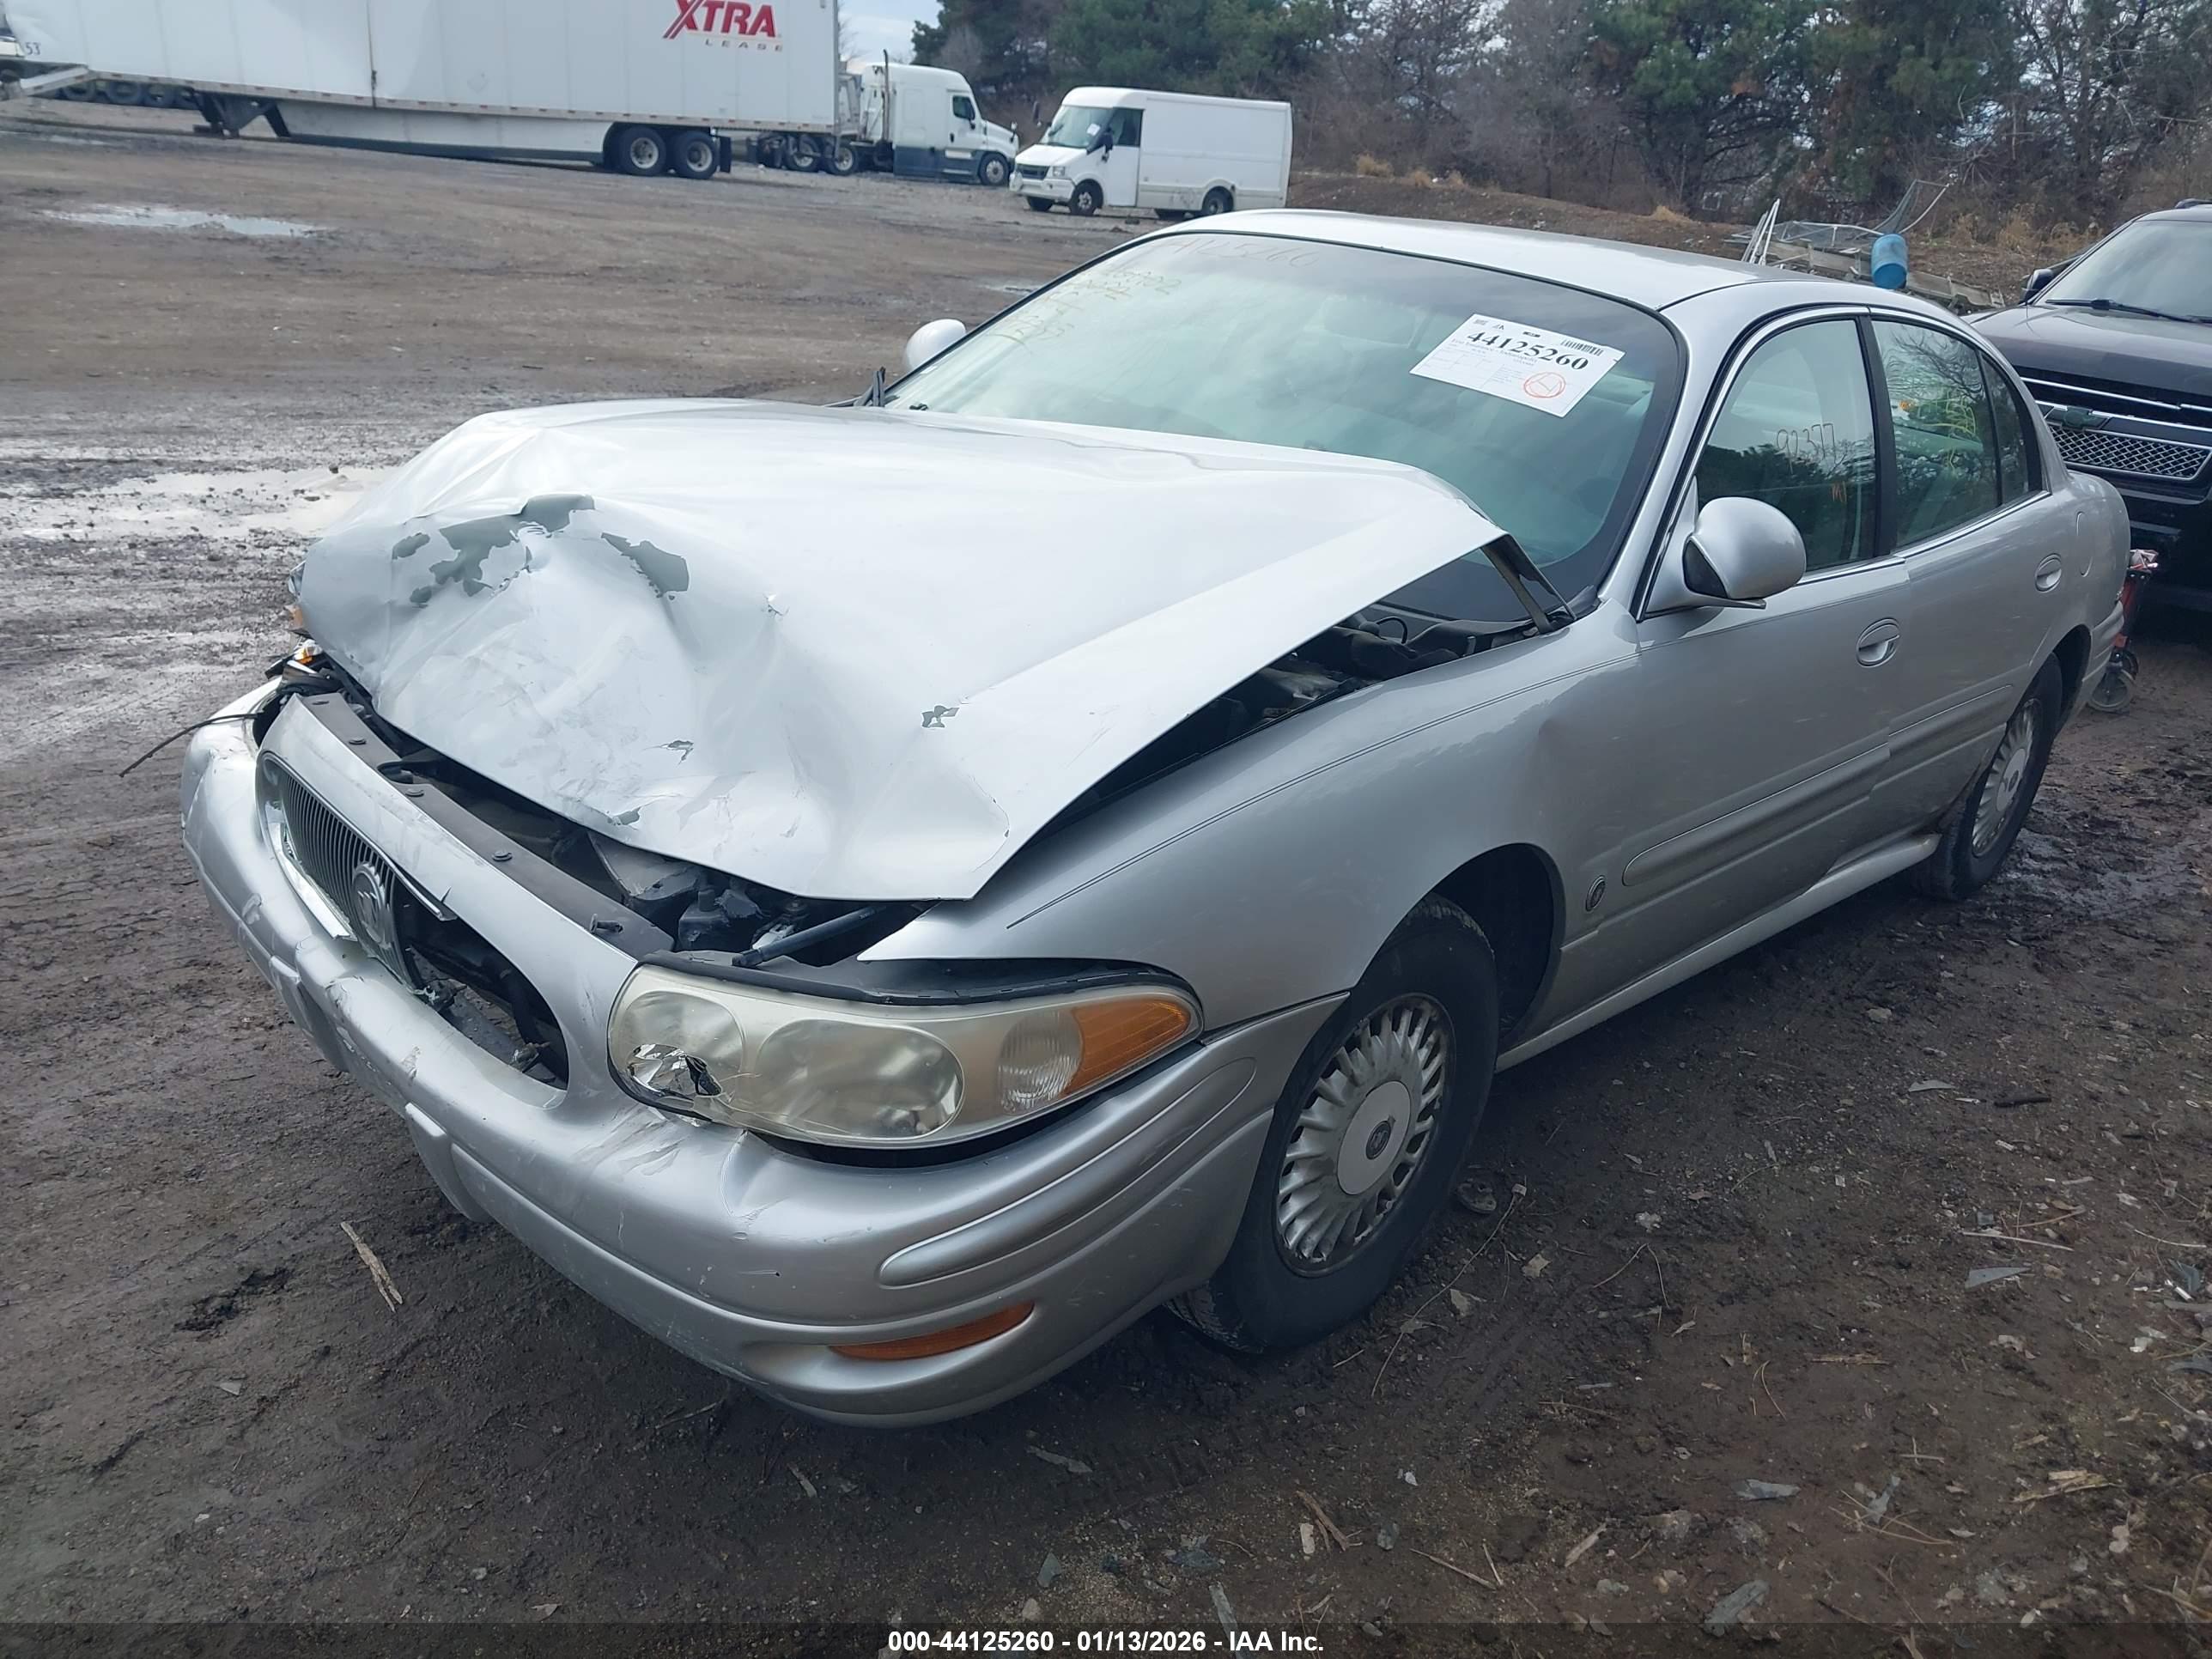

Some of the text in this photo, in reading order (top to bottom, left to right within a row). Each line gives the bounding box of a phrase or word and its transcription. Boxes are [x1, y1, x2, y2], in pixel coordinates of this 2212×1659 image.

[662, 0, 776, 40] XTRA
[25, 41, 41, 56] 53
[705, 38, 783, 52] LEASE
[1467, 331, 1589, 370] 44125260
